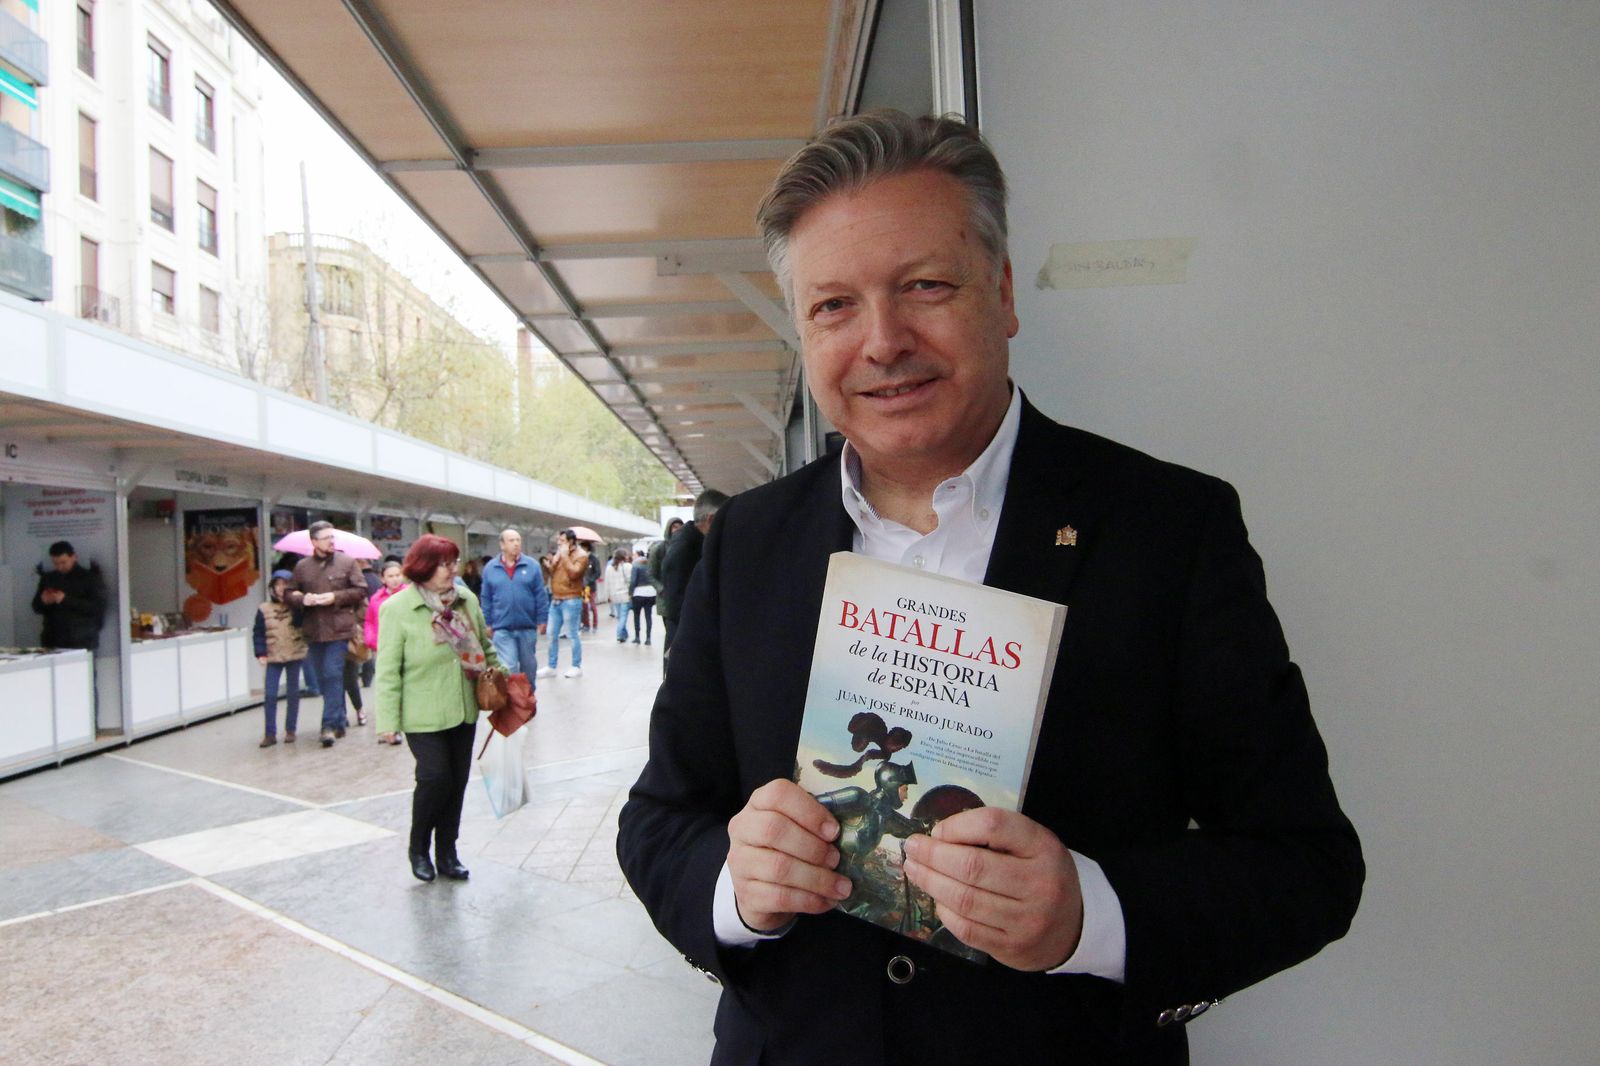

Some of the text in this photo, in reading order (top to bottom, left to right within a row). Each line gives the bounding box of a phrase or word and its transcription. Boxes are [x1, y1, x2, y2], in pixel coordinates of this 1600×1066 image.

[838, 600, 1023, 670] BATALLAS
[896, 597, 967, 624] GRANDES
[849, 640, 1000, 692] de la HISTORIA
[867, 668, 971, 708] de ESPAÑA
[835, 689, 993, 740] JUAN JOSÉ PRIMO JURADO
